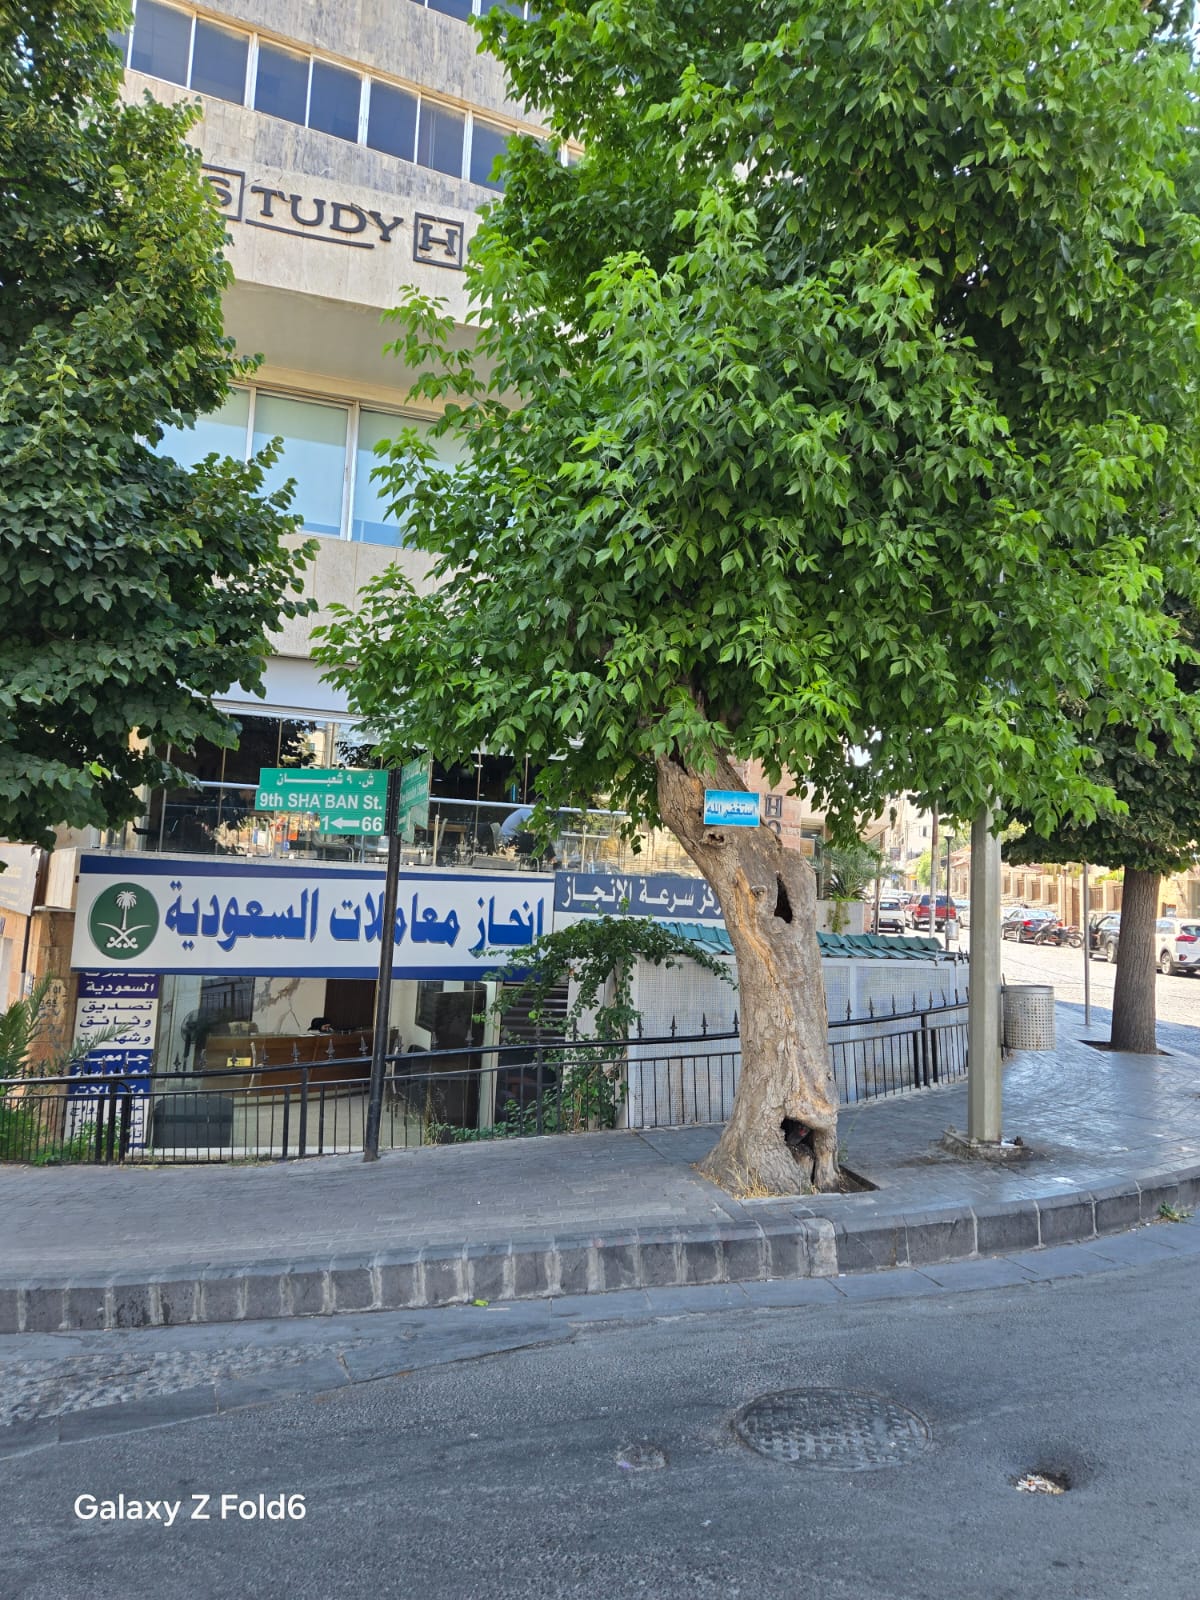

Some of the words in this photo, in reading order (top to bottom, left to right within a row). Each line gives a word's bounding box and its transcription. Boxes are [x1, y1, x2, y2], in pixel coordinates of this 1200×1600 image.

[276, 772, 344, 787] شعبان
[259, 792, 283, 808] 9th
[362, 794, 383, 810] St.
[321, 817, 329, 830] 1
[361, 817, 382, 832] 66
[639, 878, 695, 913] سرعة
[164, 880, 320, 952] السعودية
[329, 890, 461, 947] معاملات
[85, 981, 155, 995] السعودية
[81, 1001, 153, 1013] تصديق
